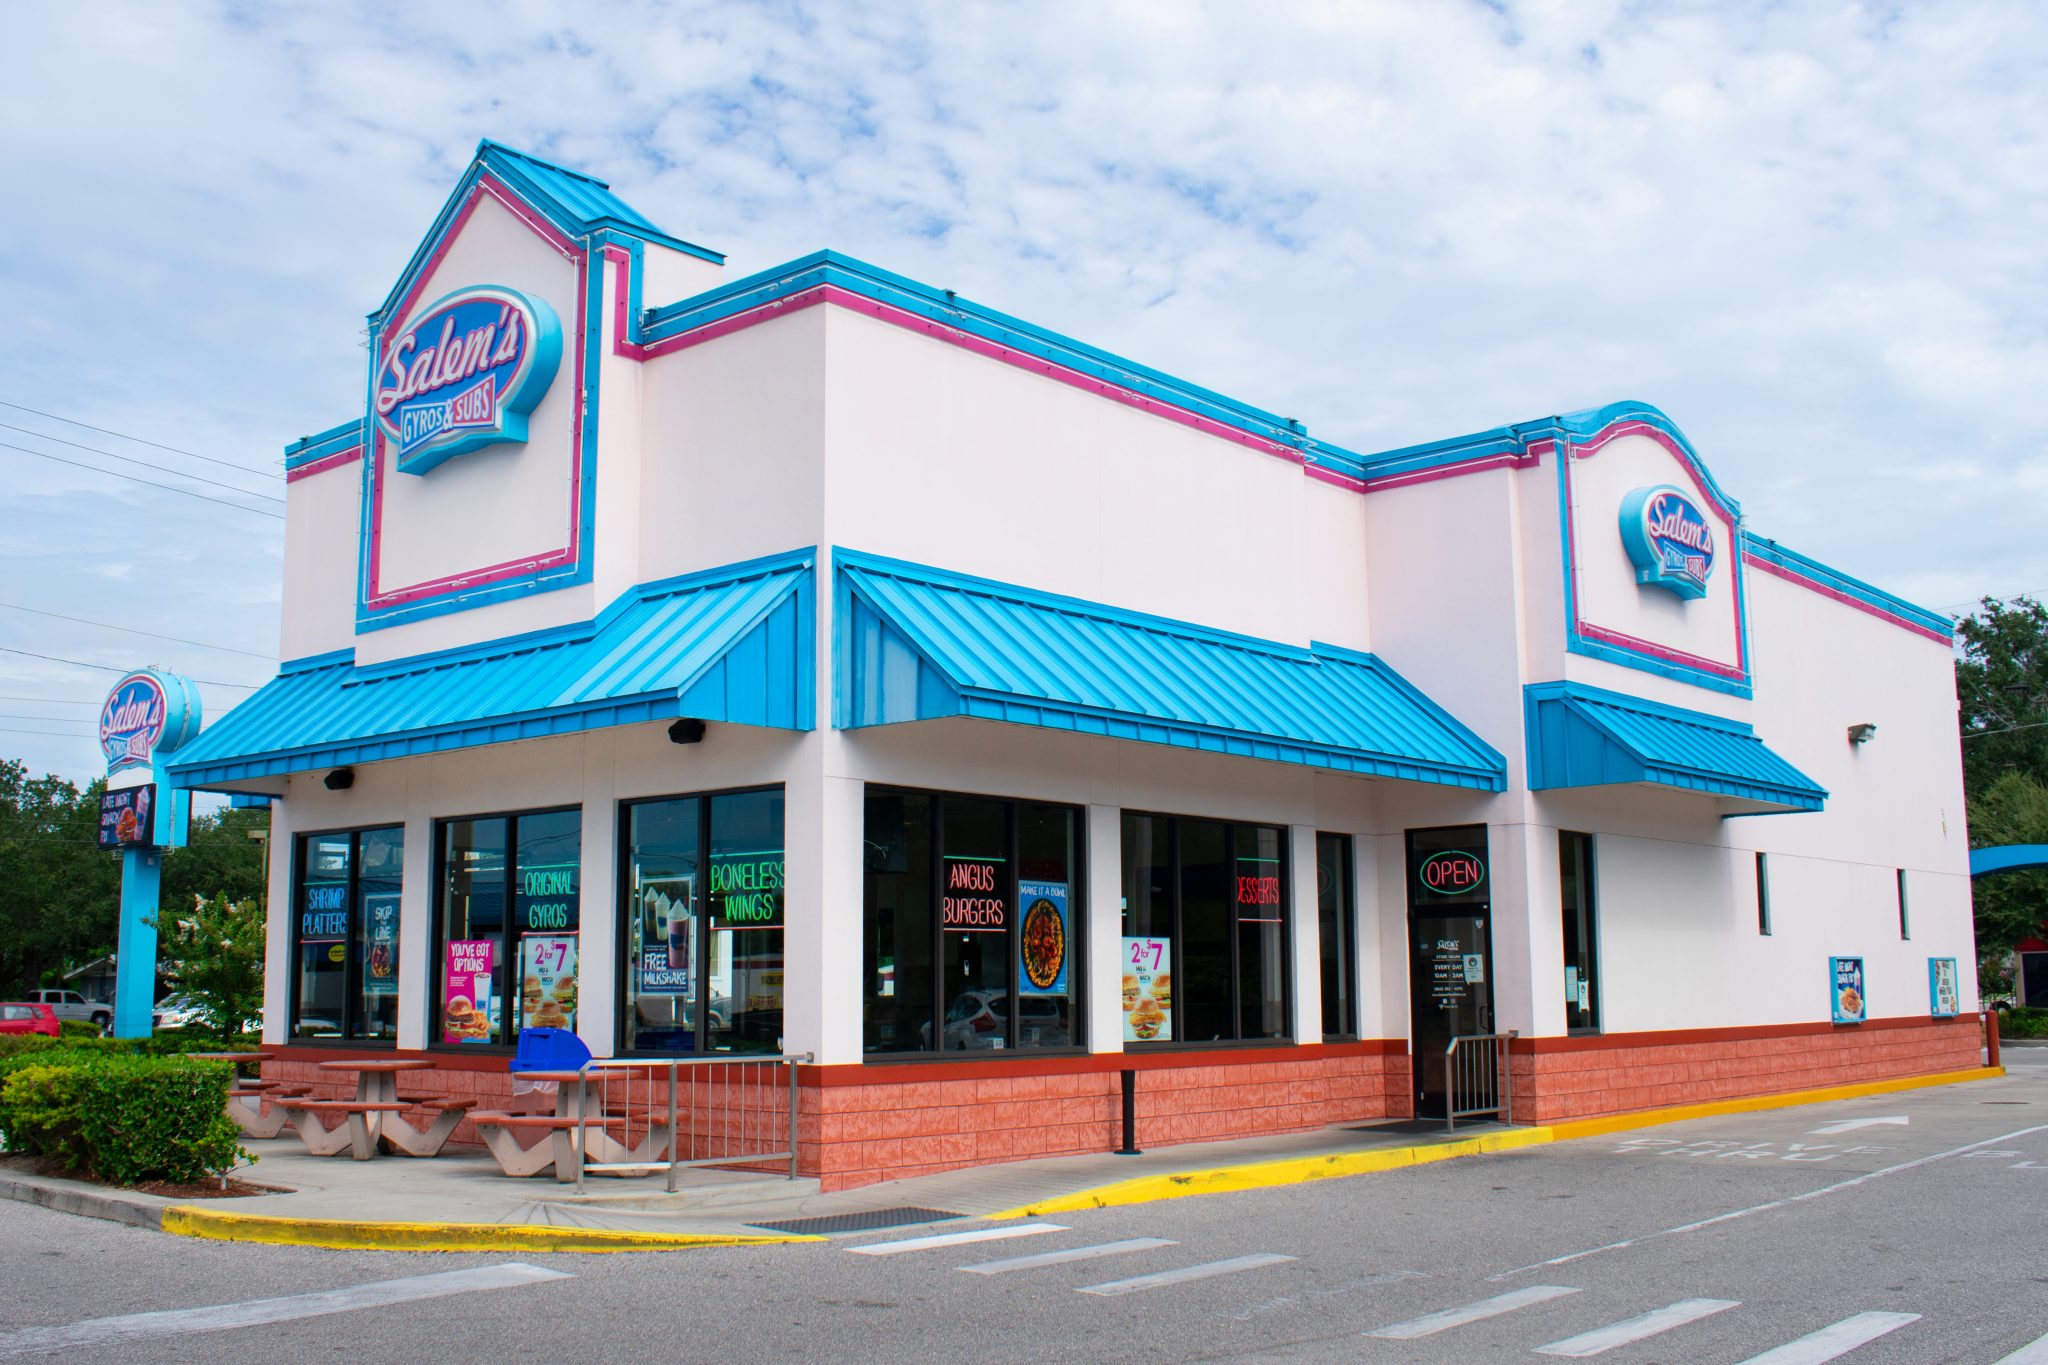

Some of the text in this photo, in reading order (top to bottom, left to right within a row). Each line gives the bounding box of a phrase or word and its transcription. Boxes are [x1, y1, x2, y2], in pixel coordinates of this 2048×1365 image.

[376, 304, 521, 415] Salem's
[403, 406, 443, 443] GYROS
[456, 381, 491, 421] SUBS
[1648, 494, 1713, 555] Salem's
[1687, 558, 1704, 580] SUBS
[102, 687, 163, 741] Salem's
[525, 870, 576, 897] ORIGINAL
[711, 861, 785, 891] BONELESS
[949, 863, 995, 891] ANGUS
[1427, 860, 1478, 886] OPEN
[309, 887, 345, 910] SHRIMP
[1020, 884, 1066, 897] MAKE IT A BOWL
[375, 905, 393, 920] SKIP
[529, 903, 568, 929] GYROS
[725, 893, 774, 921] WINGS
[943, 896, 1004, 925] BURGERS
[375, 926, 391, 941] LINE
[451, 942, 490, 957] YOU'VE GOT
[535, 943, 544, 965] 2
[1131, 942, 1141, 963] 2
[1141, 948, 1149, 959] for
[454, 957, 484, 972] OPTIONS
[644, 952, 667, 970] FREE
[644, 971, 687, 985] MILKSHAKE
[1611, 1145, 1841, 1161] THRU
[1618, 1138, 1897, 1154] DRIVE
